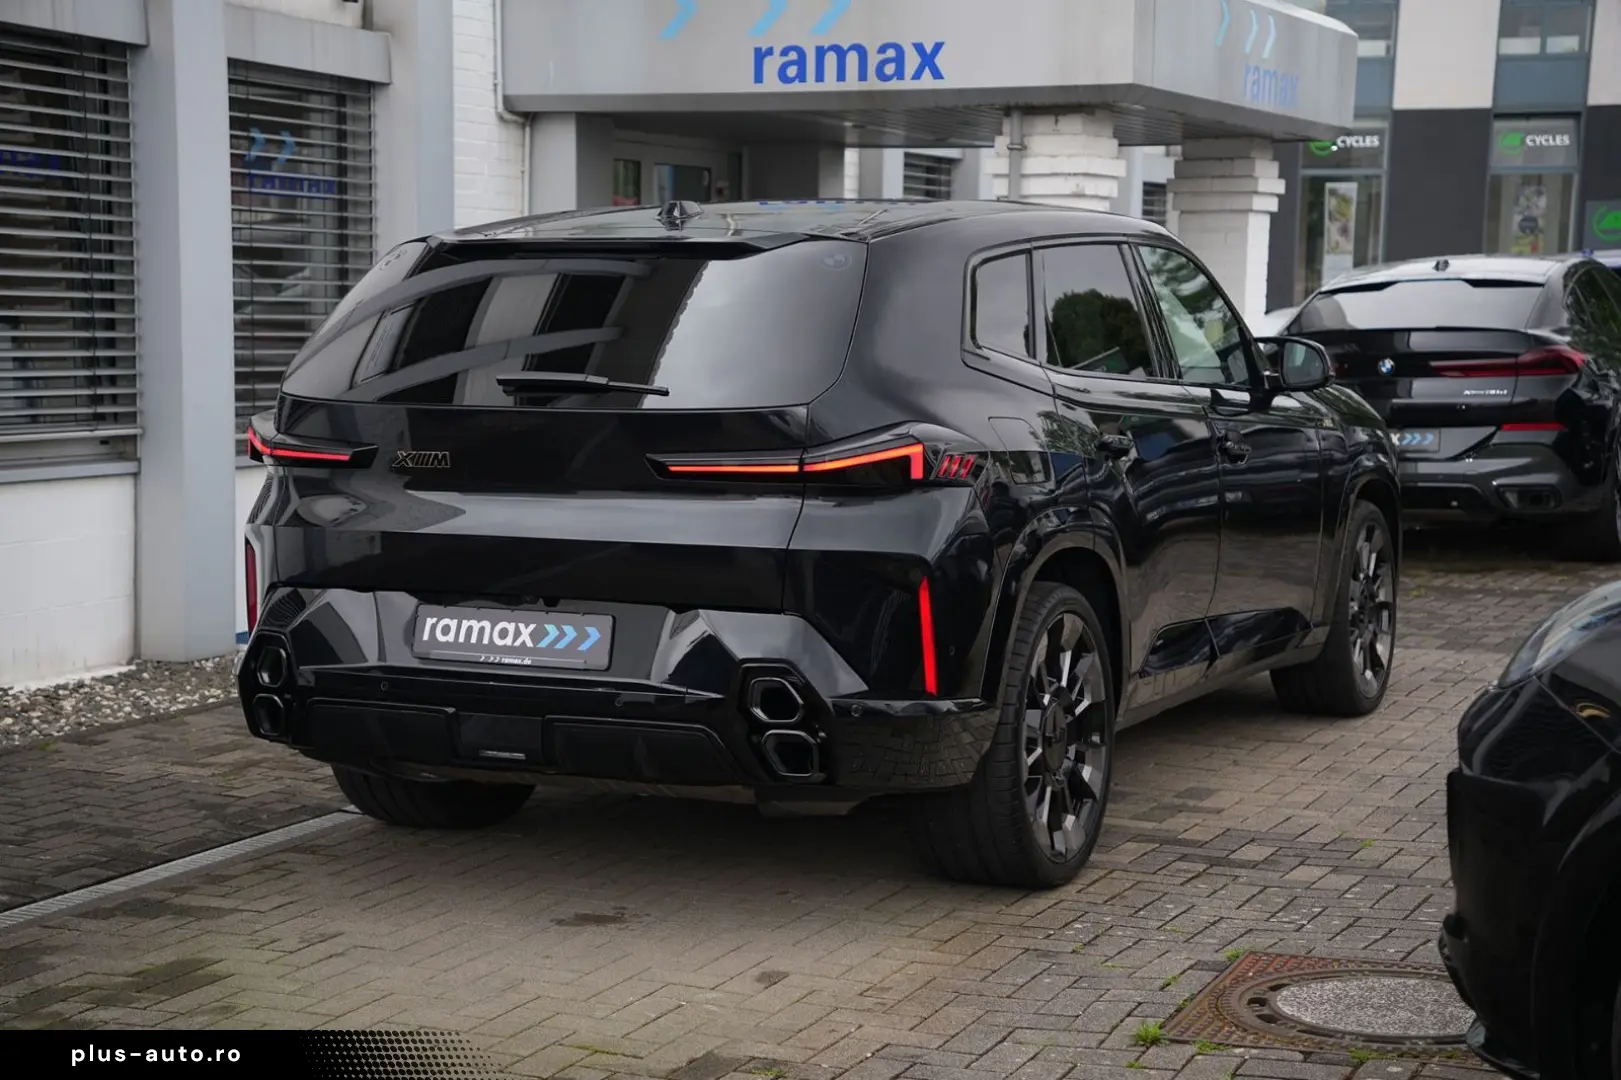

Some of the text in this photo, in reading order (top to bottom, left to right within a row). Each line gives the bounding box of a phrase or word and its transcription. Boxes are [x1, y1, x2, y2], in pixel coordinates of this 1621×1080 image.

[753, 40, 946, 84] ramax
[1244, 63, 1300, 107] ramax
[1336, 135, 1380, 148] CYCLES
[1525, 134, 1571, 147] CYCLES
[422, 615, 538, 648] ramax
[501, 657, 532, 665] ramax.de
